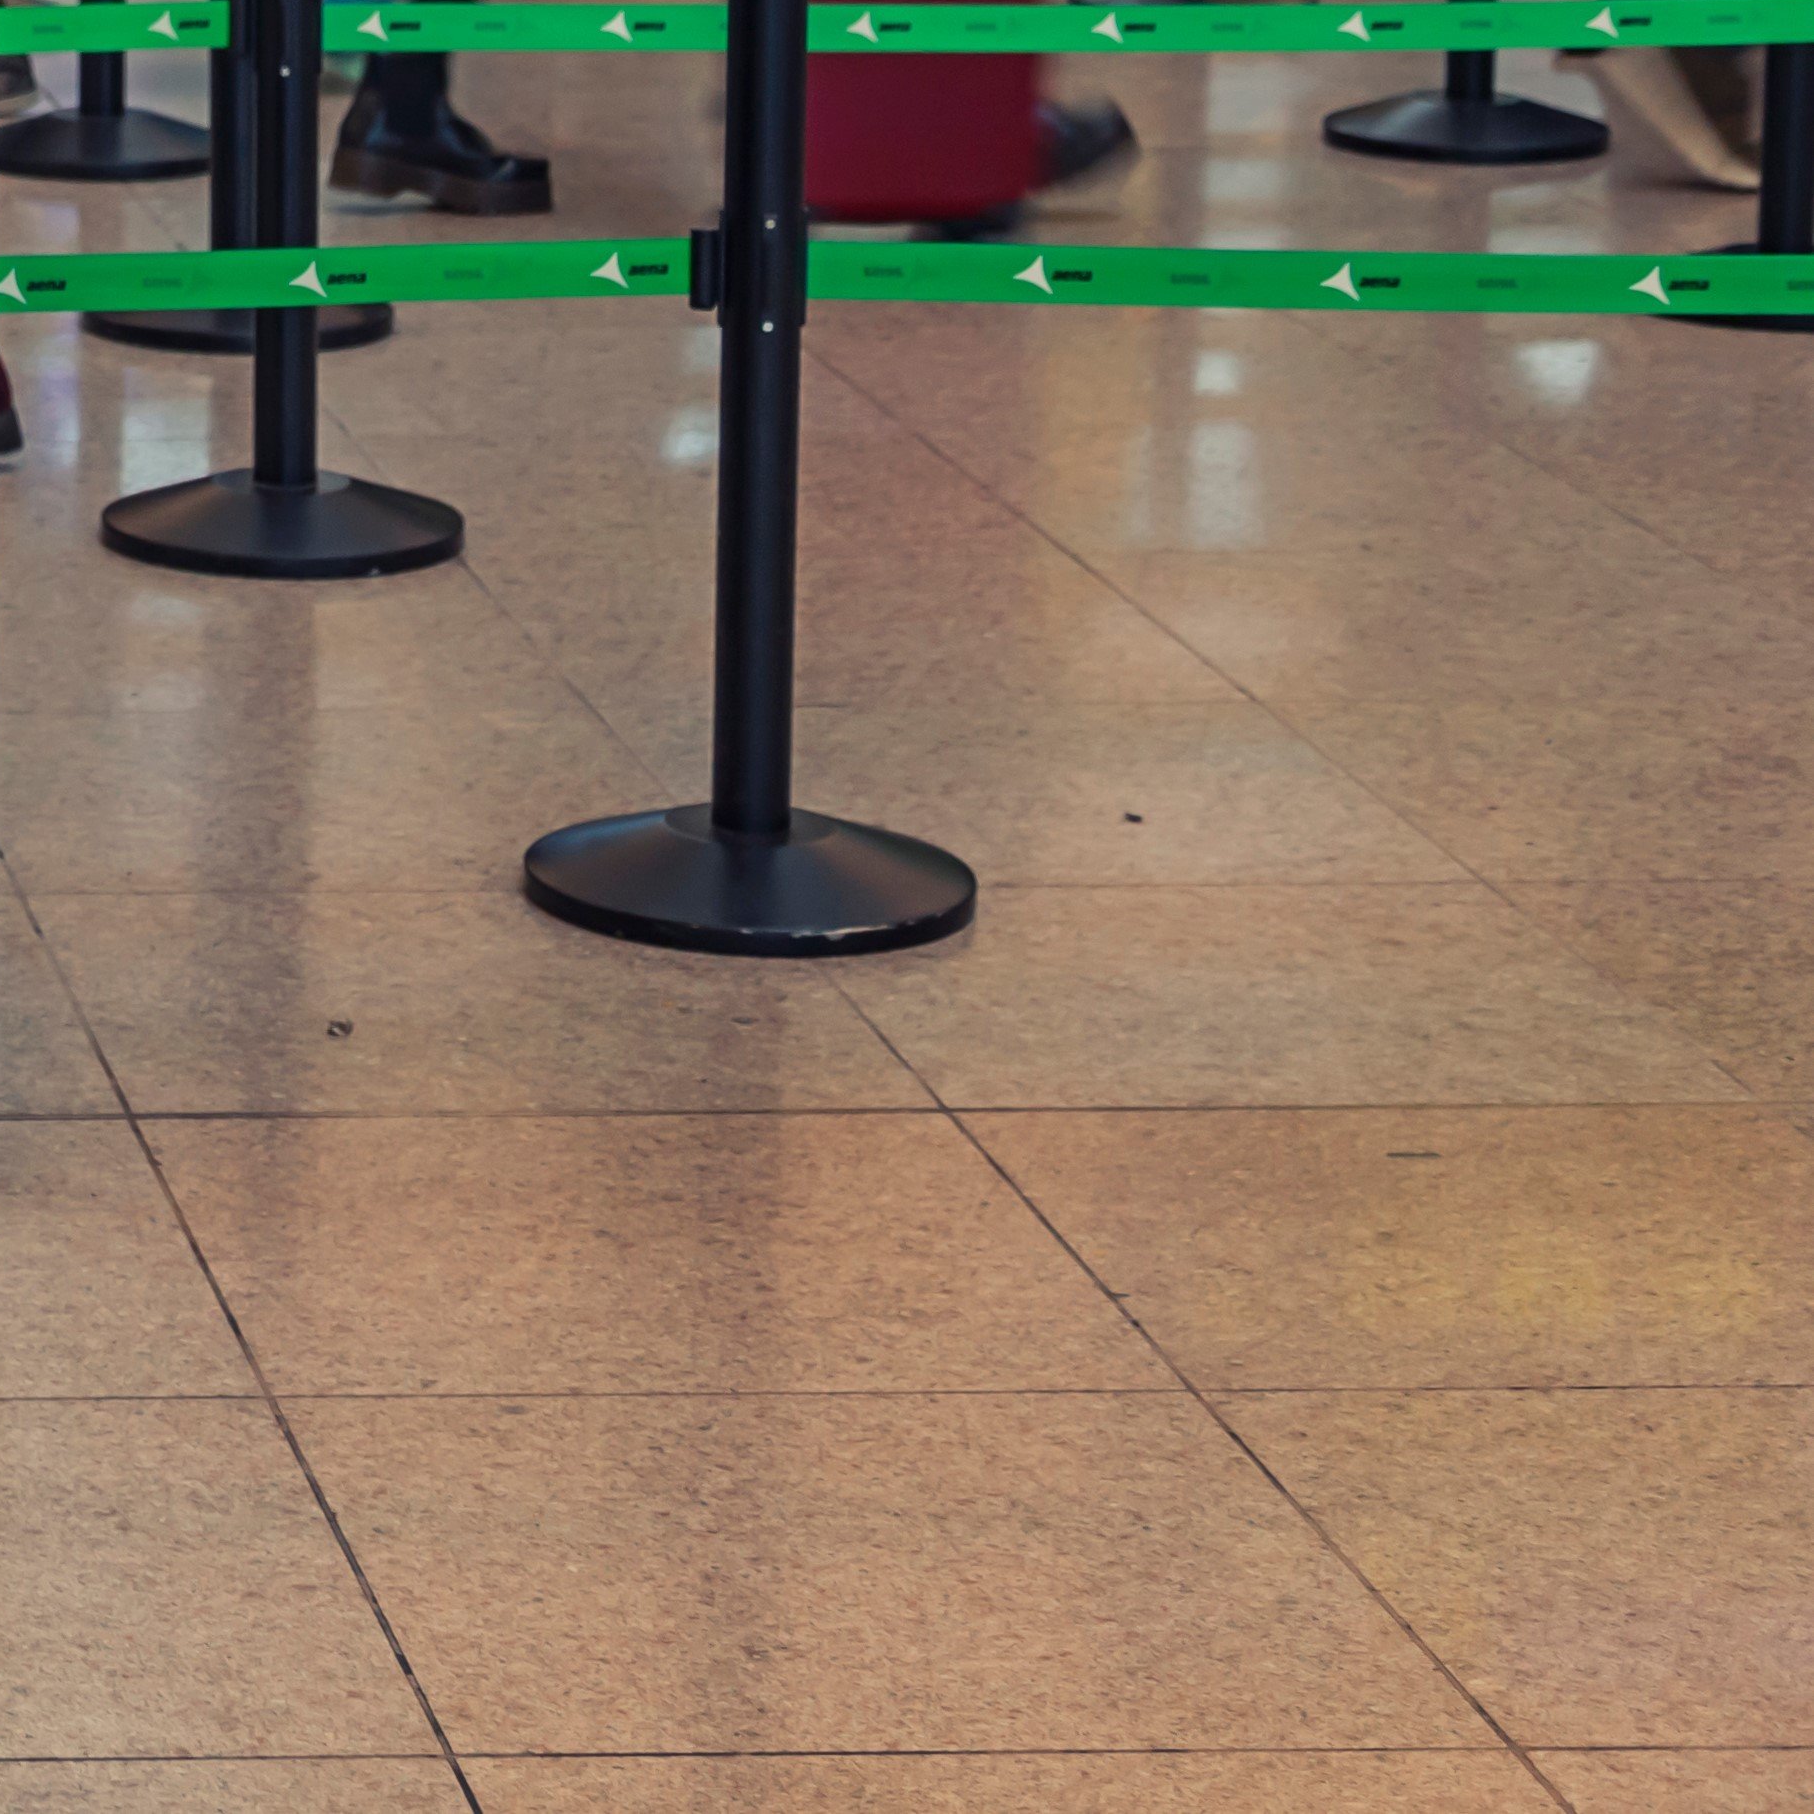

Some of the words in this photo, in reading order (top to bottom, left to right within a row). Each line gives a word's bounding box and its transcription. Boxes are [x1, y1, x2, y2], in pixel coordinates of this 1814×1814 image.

[627, 263, 669, 277] aena
[1051, 270, 1093, 283] aena
[25, 279, 67, 292] aena
[326, 272, 368, 286] aena
[1358, 276, 1401, 289] aena
[1667, 279, 1711, 292] aena
